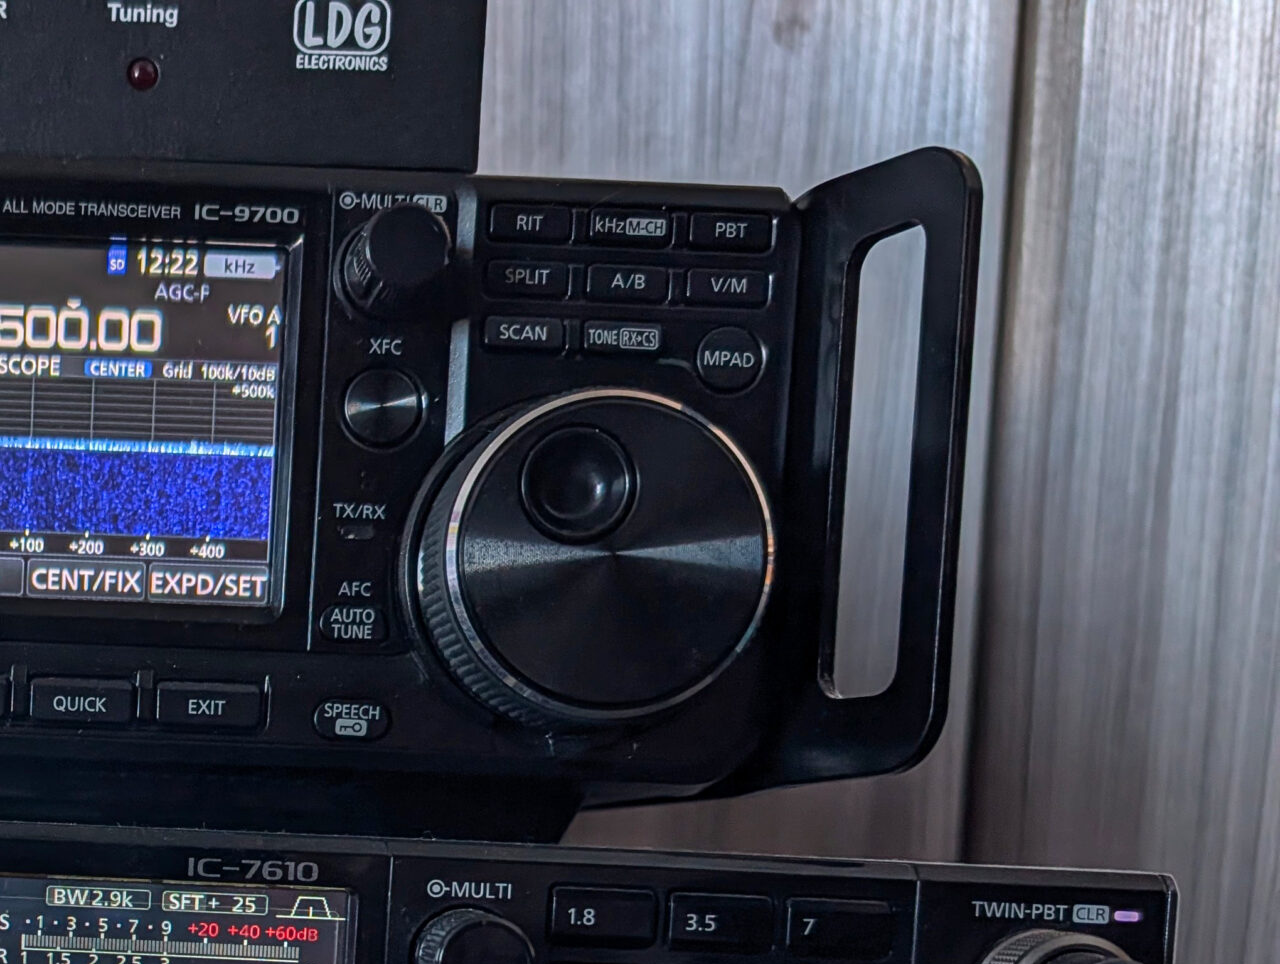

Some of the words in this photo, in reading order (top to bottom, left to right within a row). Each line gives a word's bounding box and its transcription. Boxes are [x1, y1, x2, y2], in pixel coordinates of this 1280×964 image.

[108, 3, 178, 27] Tuning
[303, 1, 381, 47] LDG
[295, 54, 388, 72] ELECTRONICS
[3, 200, 28, 214] ALL
[32, 201, 75, 215] MODE
[79, 202, 181, 219] TRANSCEIVER
[194, 206, 299, 224] IC-9700
[517, 215, 543, 231] RIT
[715, 222, 747, 239] PBT
[137, 246, 199, 275] 12:22
[224, 258, 255, 274] kHz
[505, 268, 550, 286] SPLIT
[611, 274, 646, 291] A/B
[711, 277, 747, 295] V/M
[499, 324, 548, 342] SCAN
[588, 329, 618, 345] TONE
[368, 338, 402, 356] XFC
[703, 350, 755, 368] MPAD
[90, 362, 145, 377] CENTER
[333, 503, 386, 520] TX/RX
[31, 567, 142, 593] CENT/FIX
[150, 571, 267, 597] EXPD/SET
[338, 582, 372, 597] AFC
[330, 608, 375, 624] AUTO
[331, 624, 372, 640] TUNE
[53, 695, 106, 713] QUICK
[188, 699, 226, 716] EXIT
[324, 703, 380, 720] SPEECH
[188, 857, 318, 882] IC-7610
[452, 881, 512, 899] MULTI
[568, 908, 596, 926] 1.8
[972, 901, 1068, 921] TWIN-PBT
[1075, 906, 1106, 922] CLR
[685, 914, 717, 932] 3.5
[802, 918, 816, 936] 7
